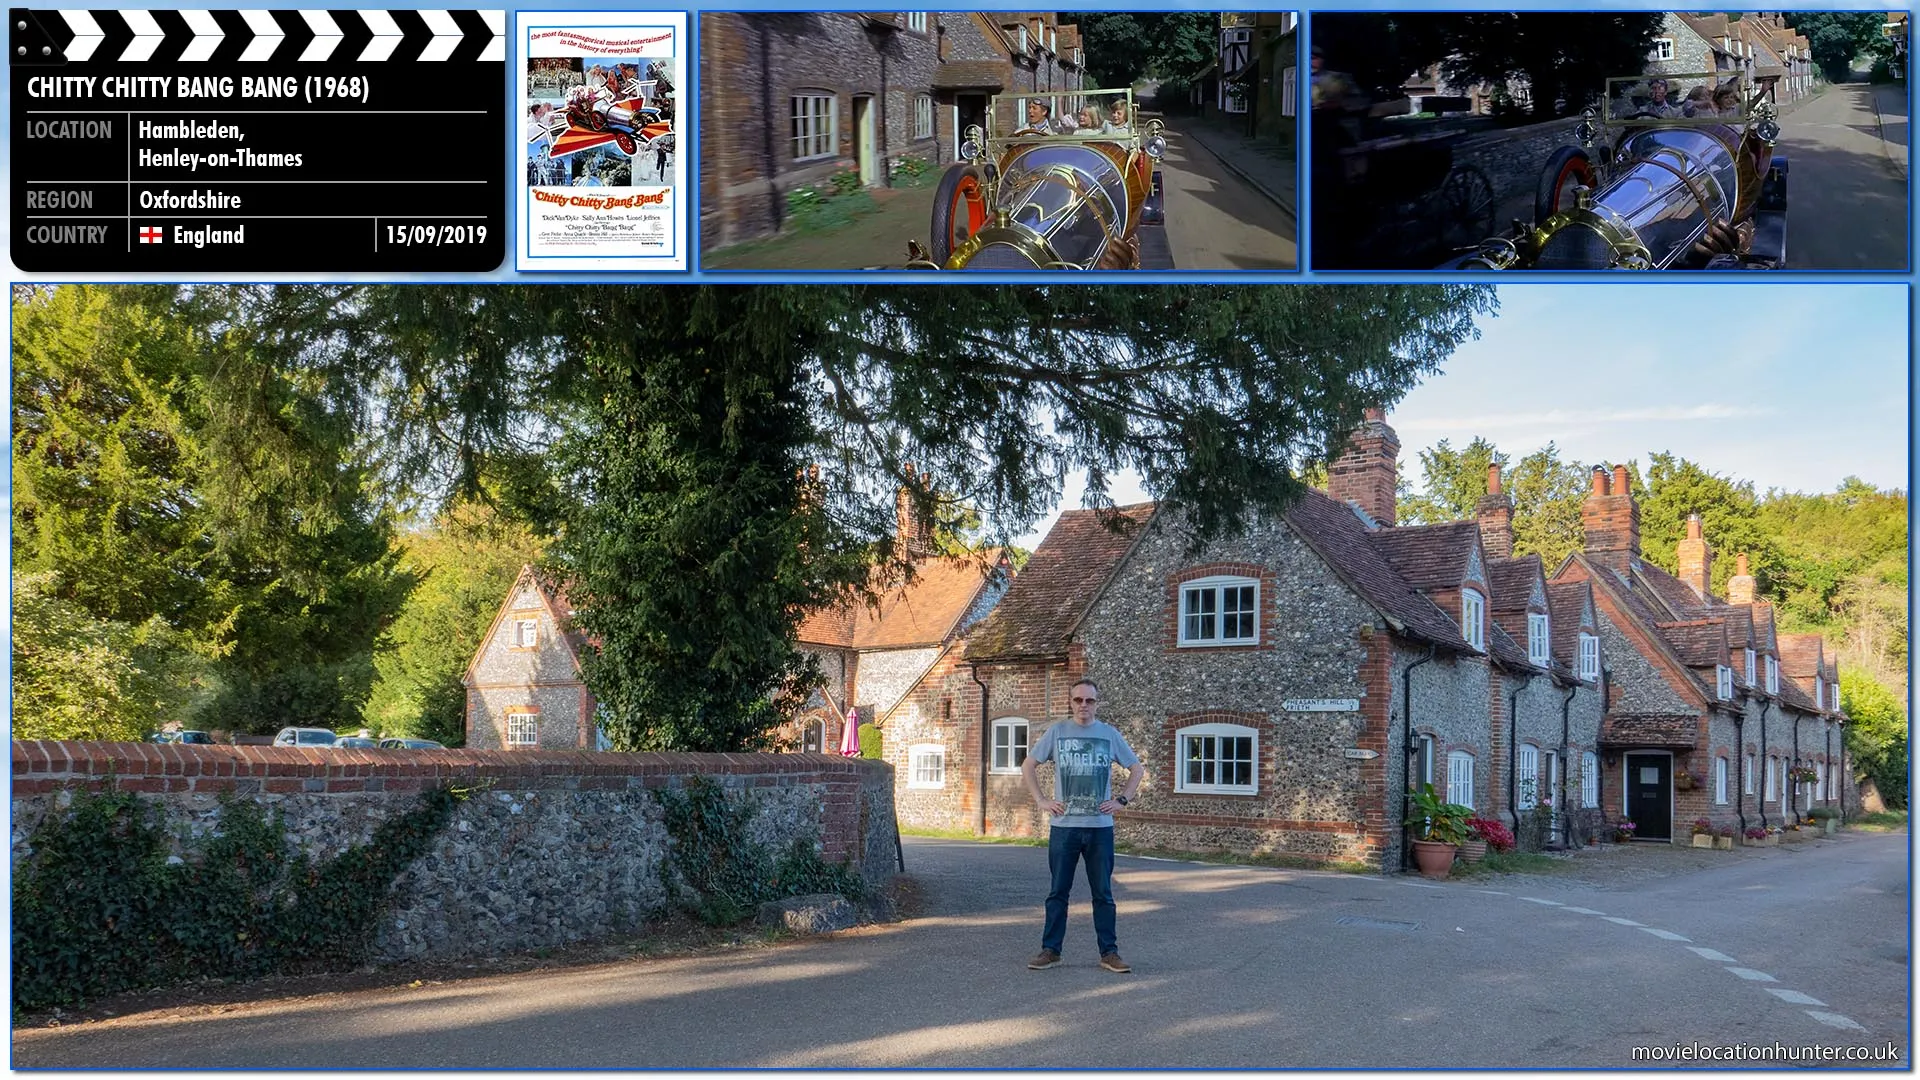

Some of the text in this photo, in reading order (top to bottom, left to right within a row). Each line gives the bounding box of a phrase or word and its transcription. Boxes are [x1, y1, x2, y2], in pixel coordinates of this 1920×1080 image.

[531, 32, 540, 40] the
[542, 30, 556, 38] most
[558, 30, 605, 45] fantasmagorical
[630, 32, 672, 45] entertainment
[577, 42, 599, 53] history
[608, 46, 643, 55] everything!
[570, 196, 605, 210] Chitty
[602, 195, 634, 209] Bang
[1058, 739, 1079, 752] LOS
[1060, 753, 1109, 767] ANGELES
